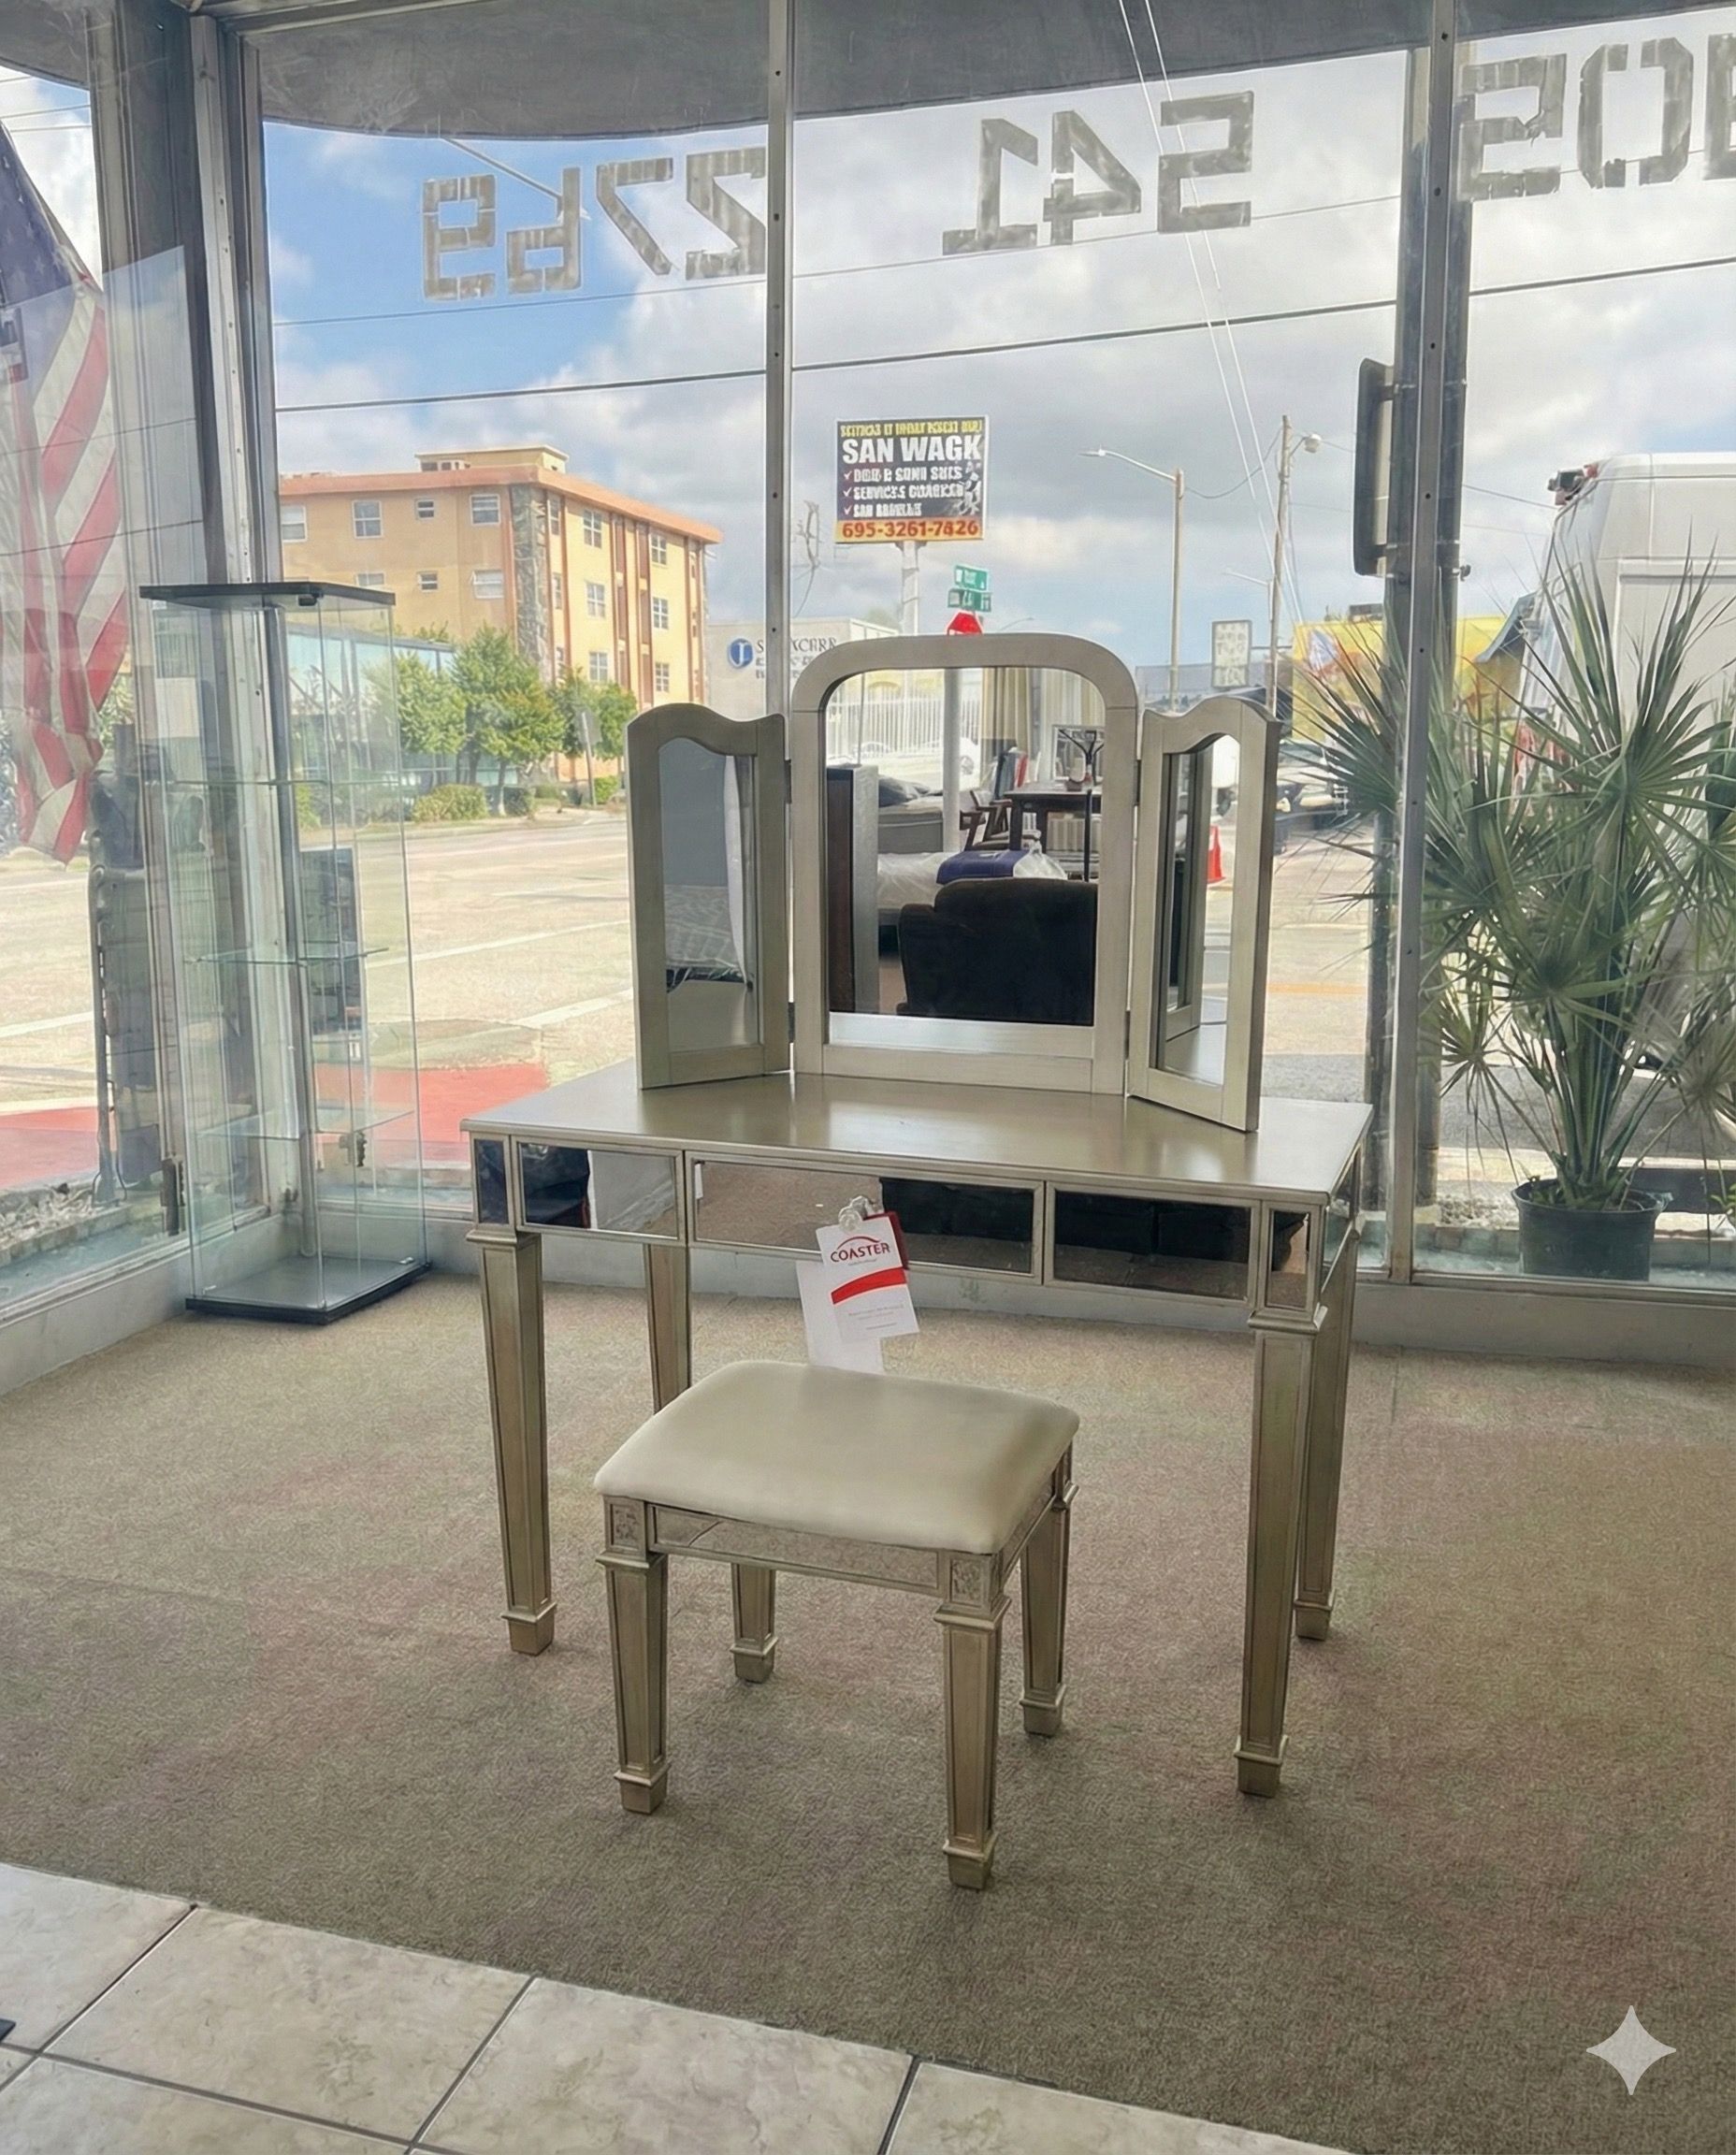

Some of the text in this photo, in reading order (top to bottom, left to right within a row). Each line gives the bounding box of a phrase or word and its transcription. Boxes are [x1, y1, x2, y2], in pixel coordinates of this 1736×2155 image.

[842, 437, 894, 464] SAN
[842, 520, 979, 538] 695-3261-7826
[830, 1242, 890, 1263] COASTER
